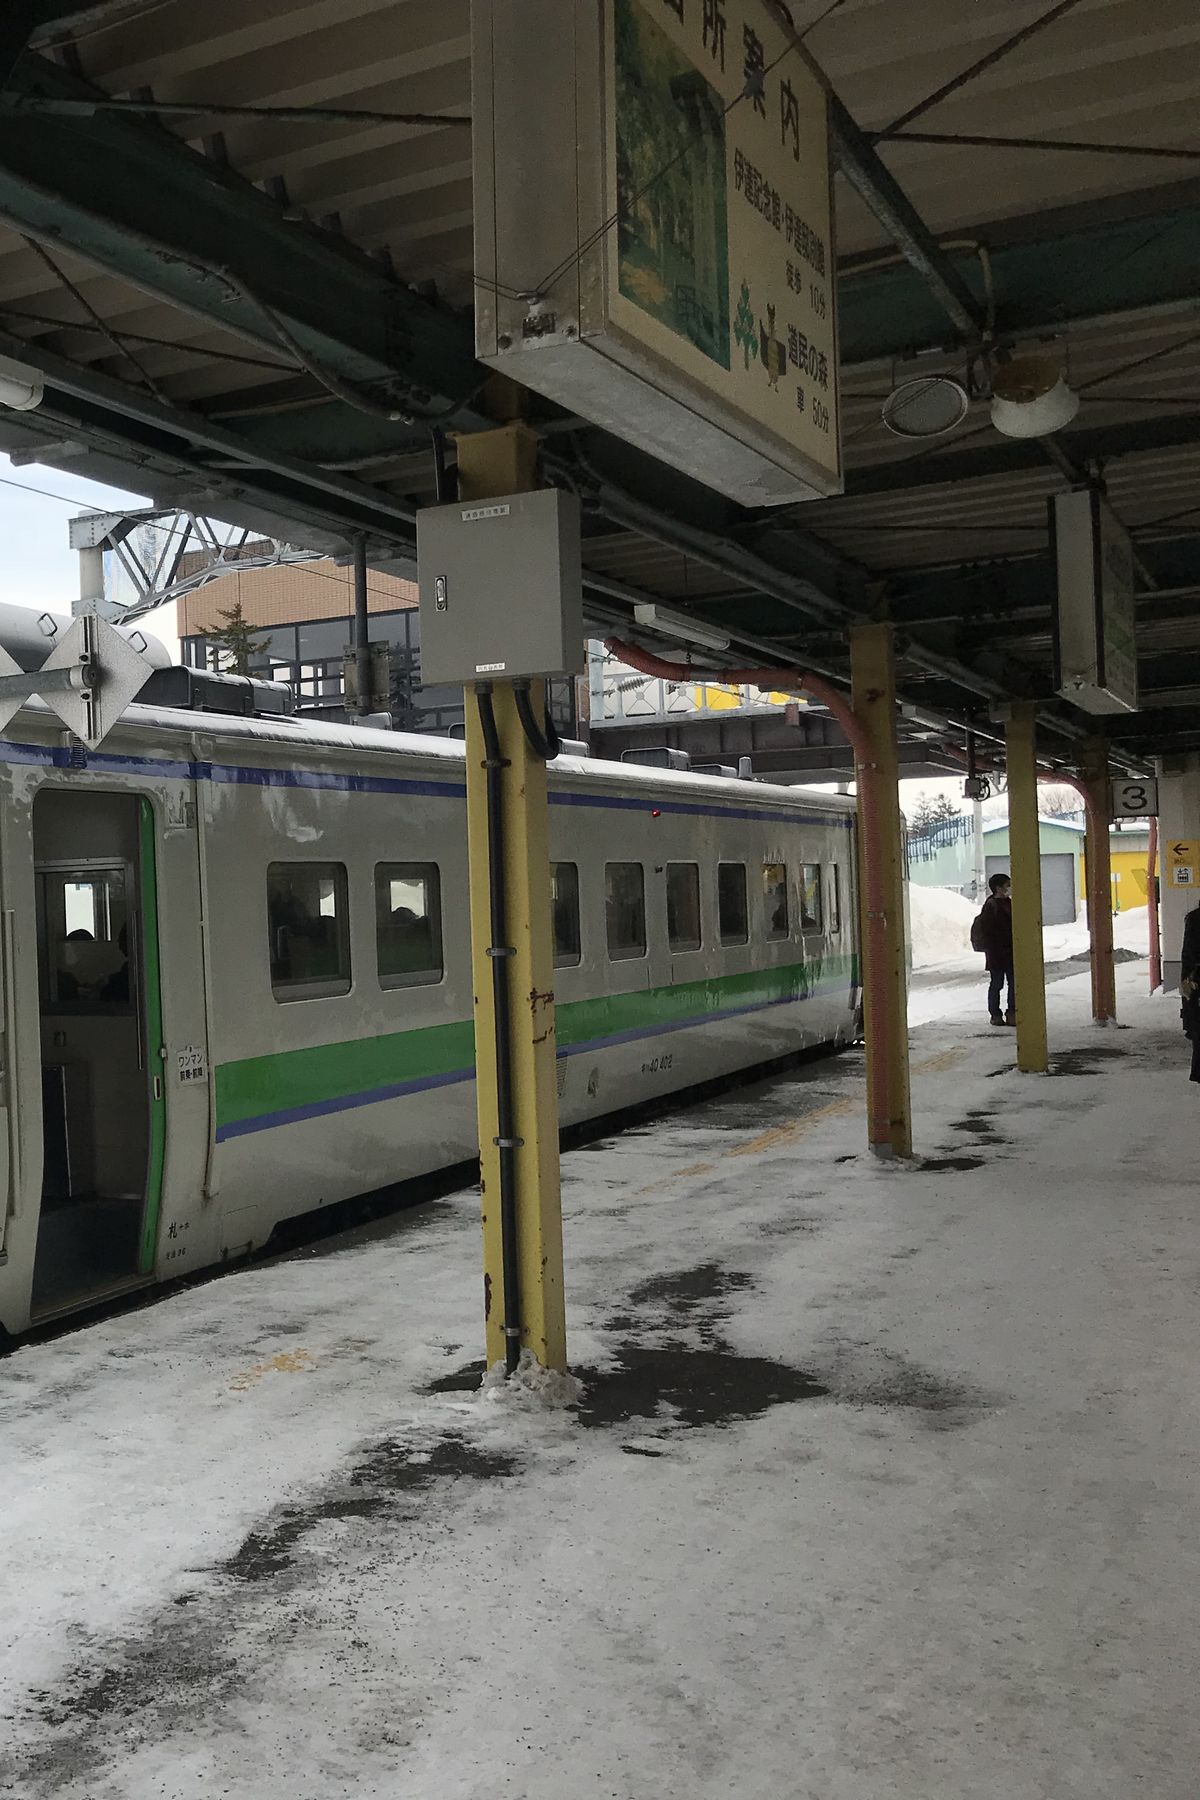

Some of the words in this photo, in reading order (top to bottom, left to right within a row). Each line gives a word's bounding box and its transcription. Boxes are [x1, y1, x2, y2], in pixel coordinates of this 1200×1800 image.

[664, 0, 800, 162] 所案内
[788, 322, 828, 391] 道民の森
[813, 397, 828, 433] 50分
[1122, 786, 1147, 810] 3
[179, 1053, 203, 1068] ワンマン
